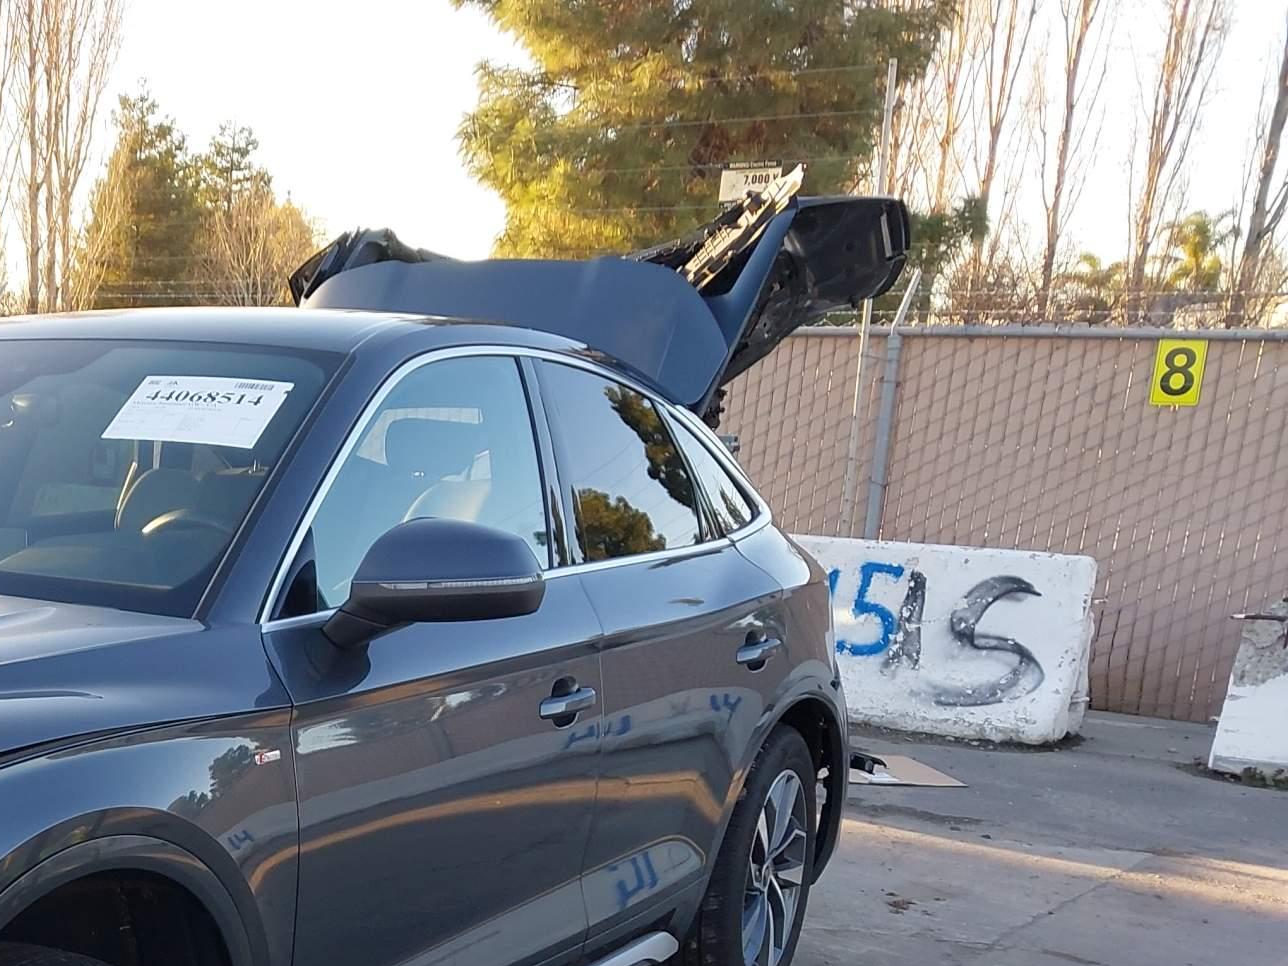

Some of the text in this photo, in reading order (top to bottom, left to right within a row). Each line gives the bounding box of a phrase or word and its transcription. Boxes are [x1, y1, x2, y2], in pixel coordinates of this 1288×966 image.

[743, 173, 770, 186] 7,000
[1159, 347, 1196, 396] 8
[145, 388, 264, 407] 44068514
